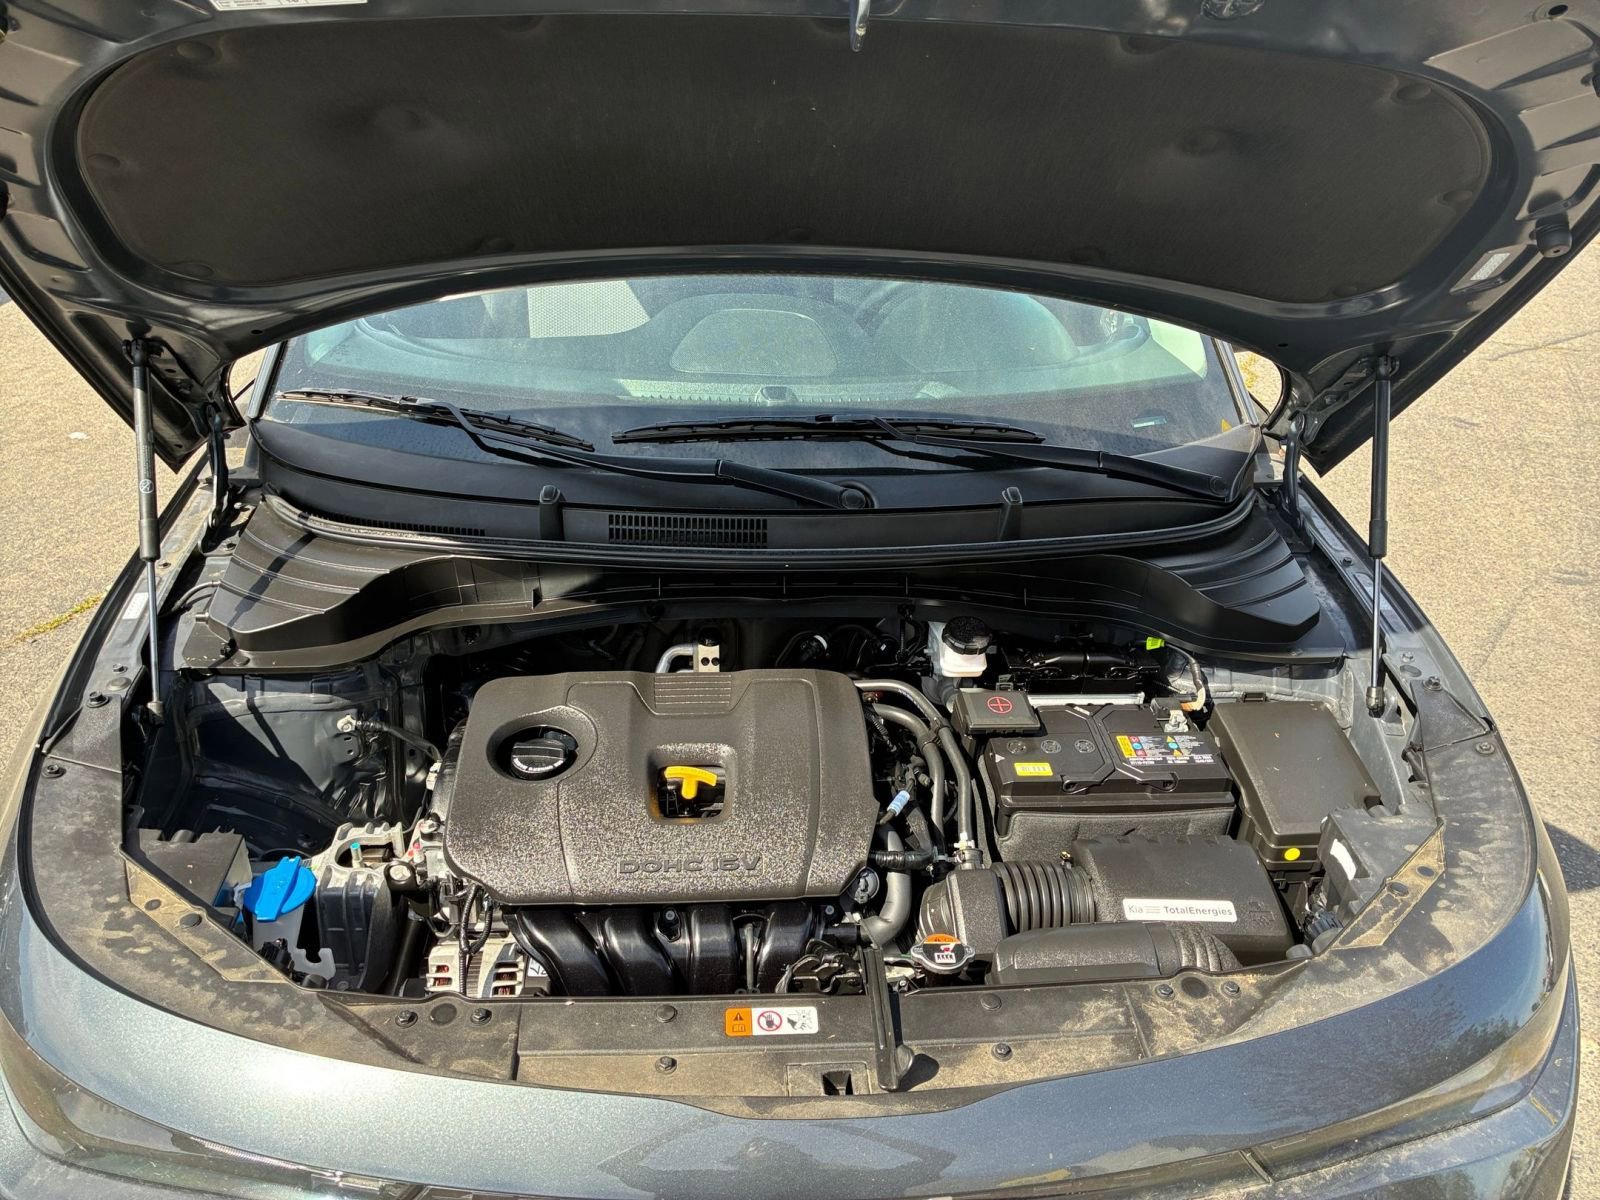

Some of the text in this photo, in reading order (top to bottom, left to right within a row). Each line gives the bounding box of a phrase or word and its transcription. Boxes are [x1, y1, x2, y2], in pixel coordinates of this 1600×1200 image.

[618, 855, 762, 874] DOHC 16V
[1128, 904, 1233, 917] Kia TotalEnergies
